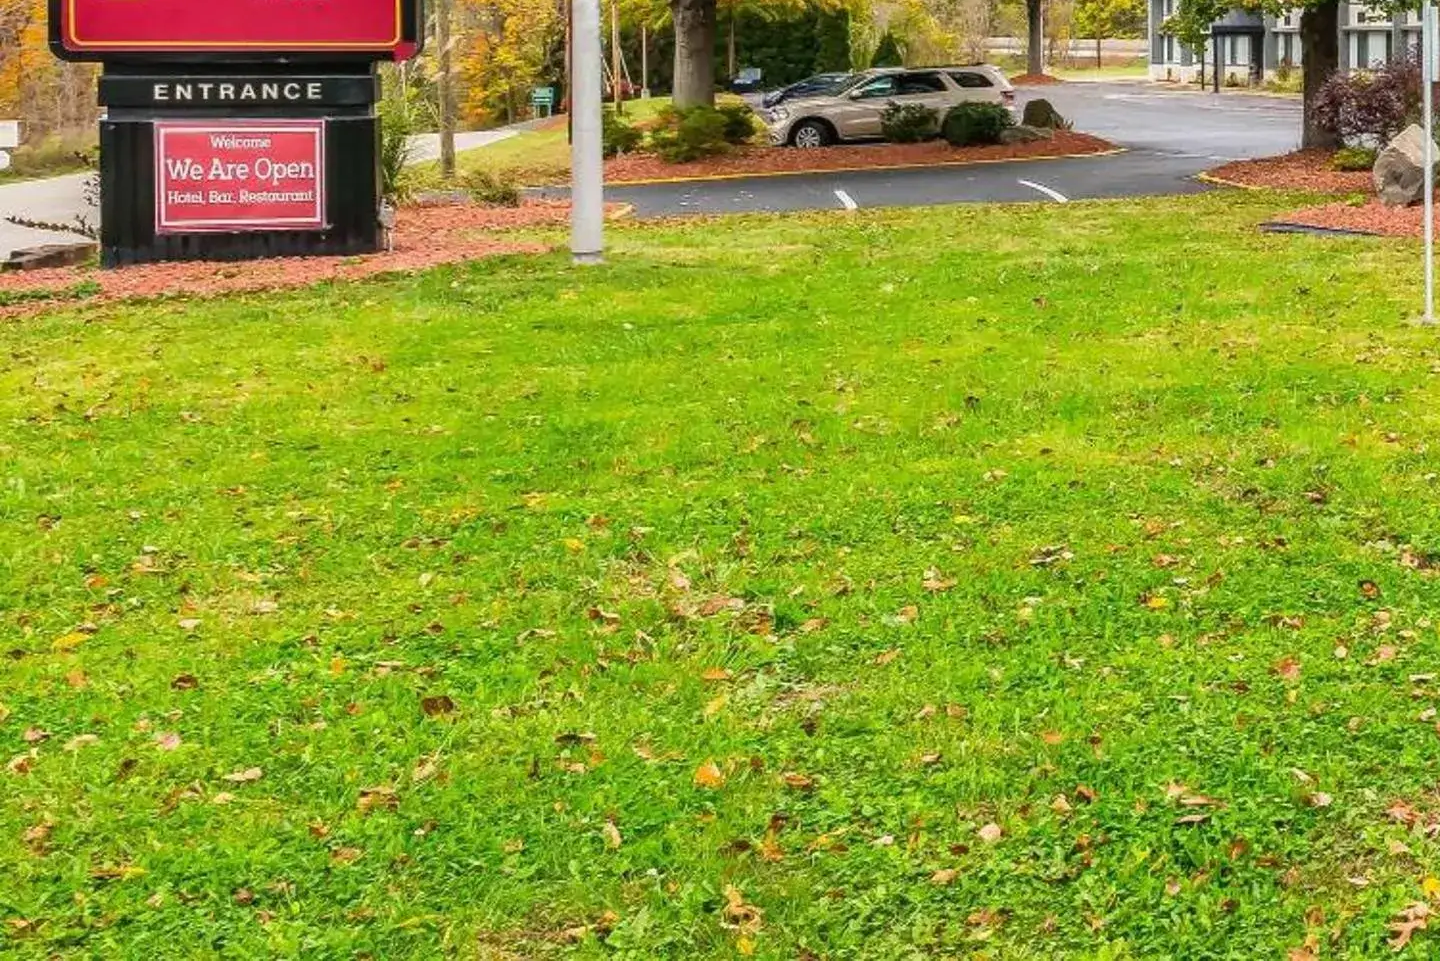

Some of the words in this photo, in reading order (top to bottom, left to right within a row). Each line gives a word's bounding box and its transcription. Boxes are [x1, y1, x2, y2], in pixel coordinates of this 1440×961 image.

[154, 82, 323, 100] ENTRANCE
[210, 135, 271, 149] Welcome
[167, 158, 204, 180] We
[208, 158, 248, 180] Are
[254, 157, 315, 186] Open
[239, 190, 314, 203] Restaurant
